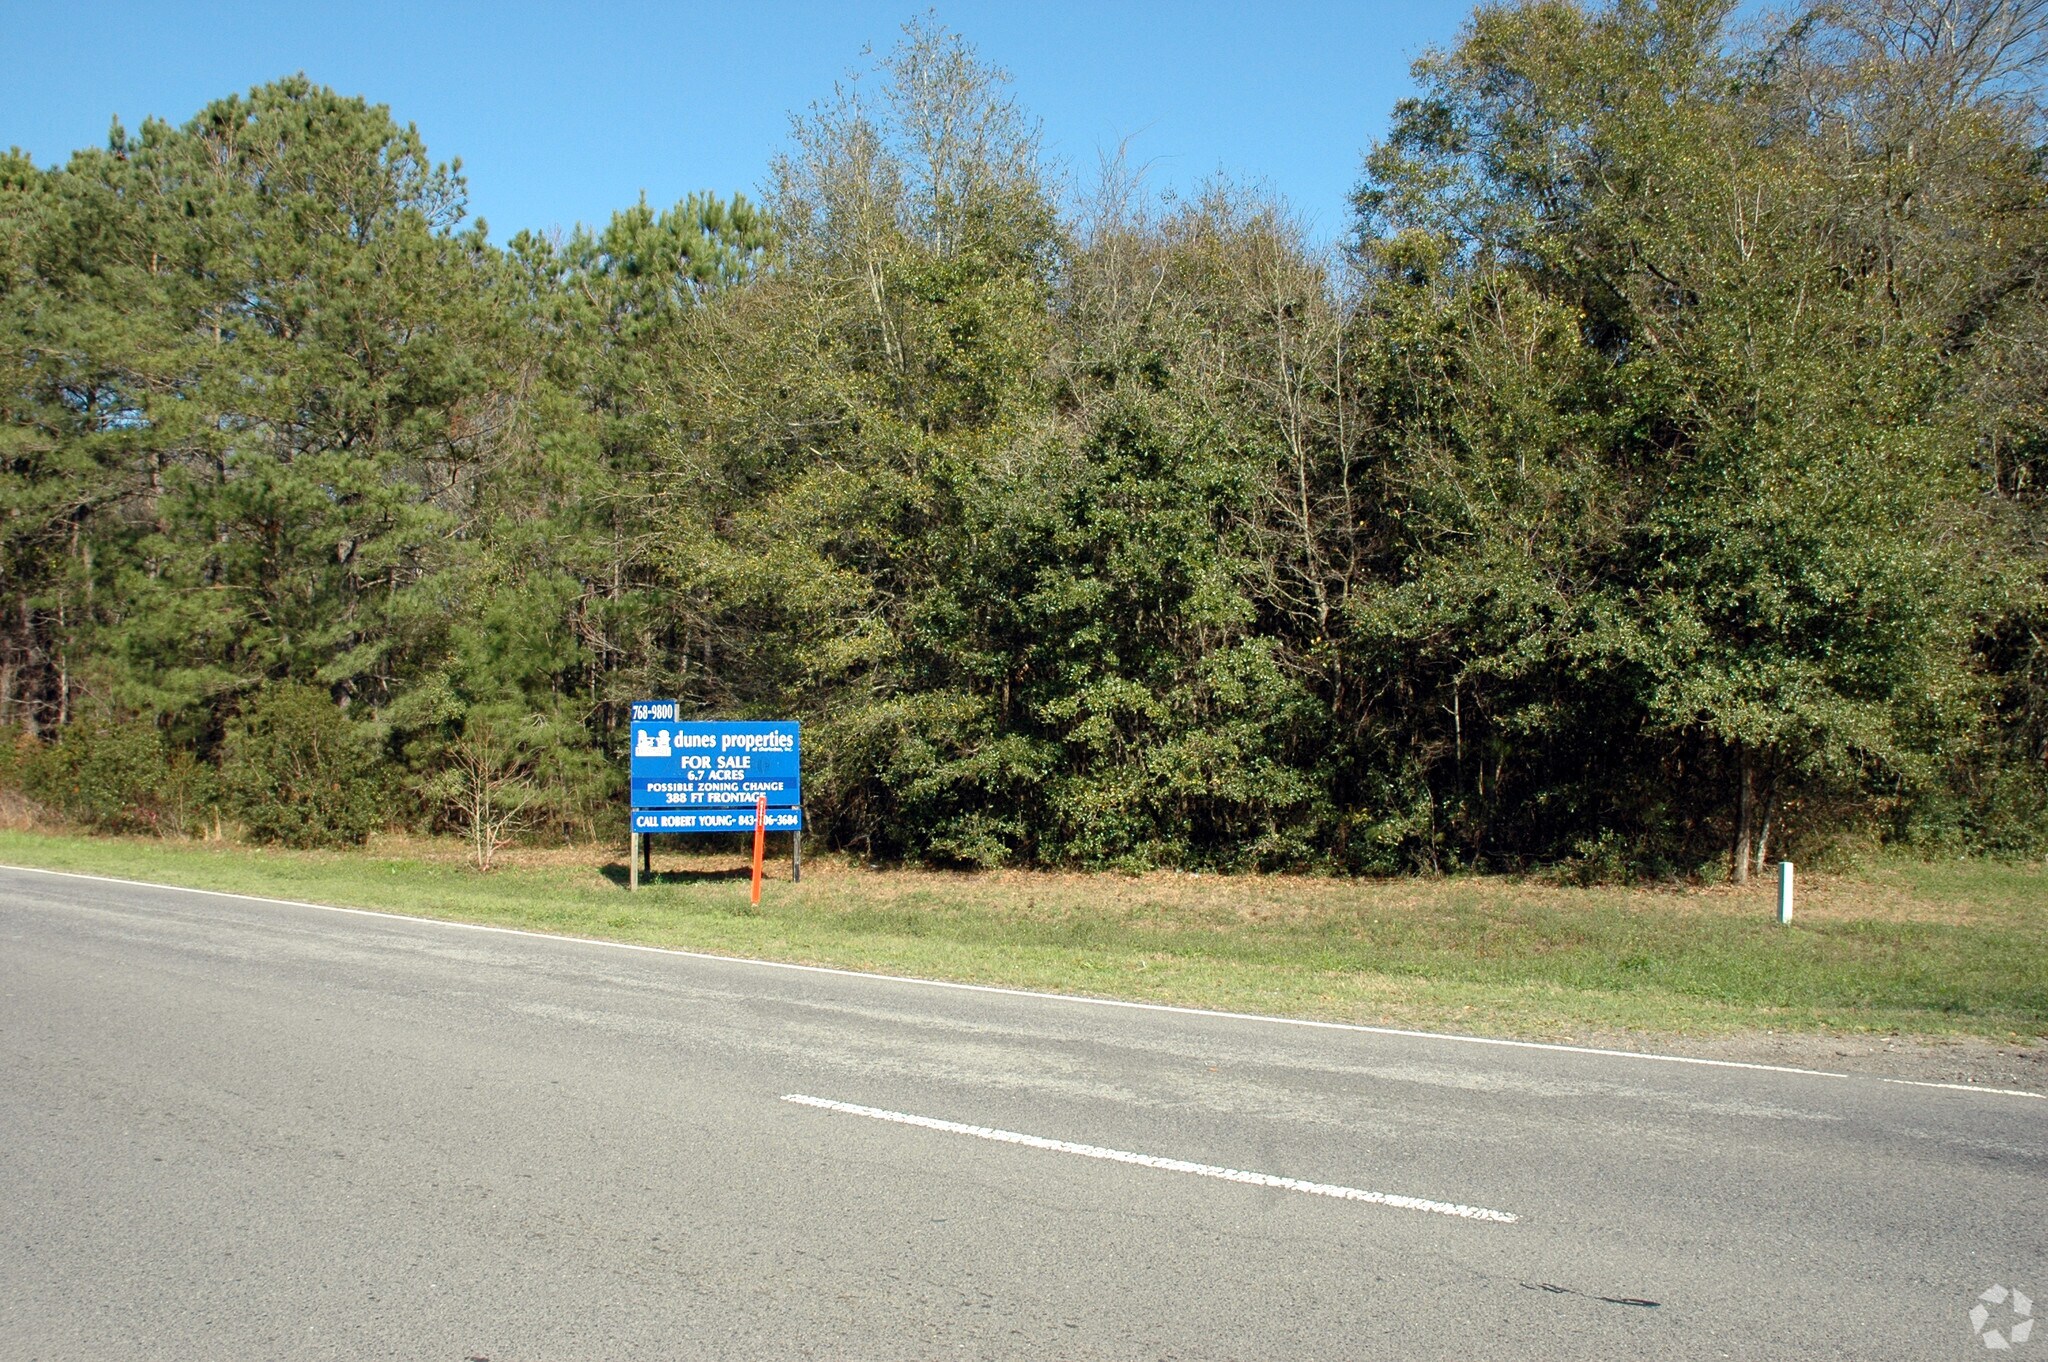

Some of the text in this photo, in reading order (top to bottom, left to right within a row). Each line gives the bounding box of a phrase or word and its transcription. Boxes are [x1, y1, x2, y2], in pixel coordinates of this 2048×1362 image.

[633, 704, 673, 719] 768-9800
[674, 730, 794, 752] dunes properties
[681, 756, 750, 769] FOR SALE
[688, 770, 744, 781] 6.7 ACRES
[648, 782, 783, 791] POSSIBLE ZONING CHANGE
[666, 793, 686, 803] 388
[691, 793, 704, 802] FT
[637, 816, 658, 827] CALL
[661, 816, 696, 826] ROBERT
[739, 815, 798, 826] 843-06-3684
